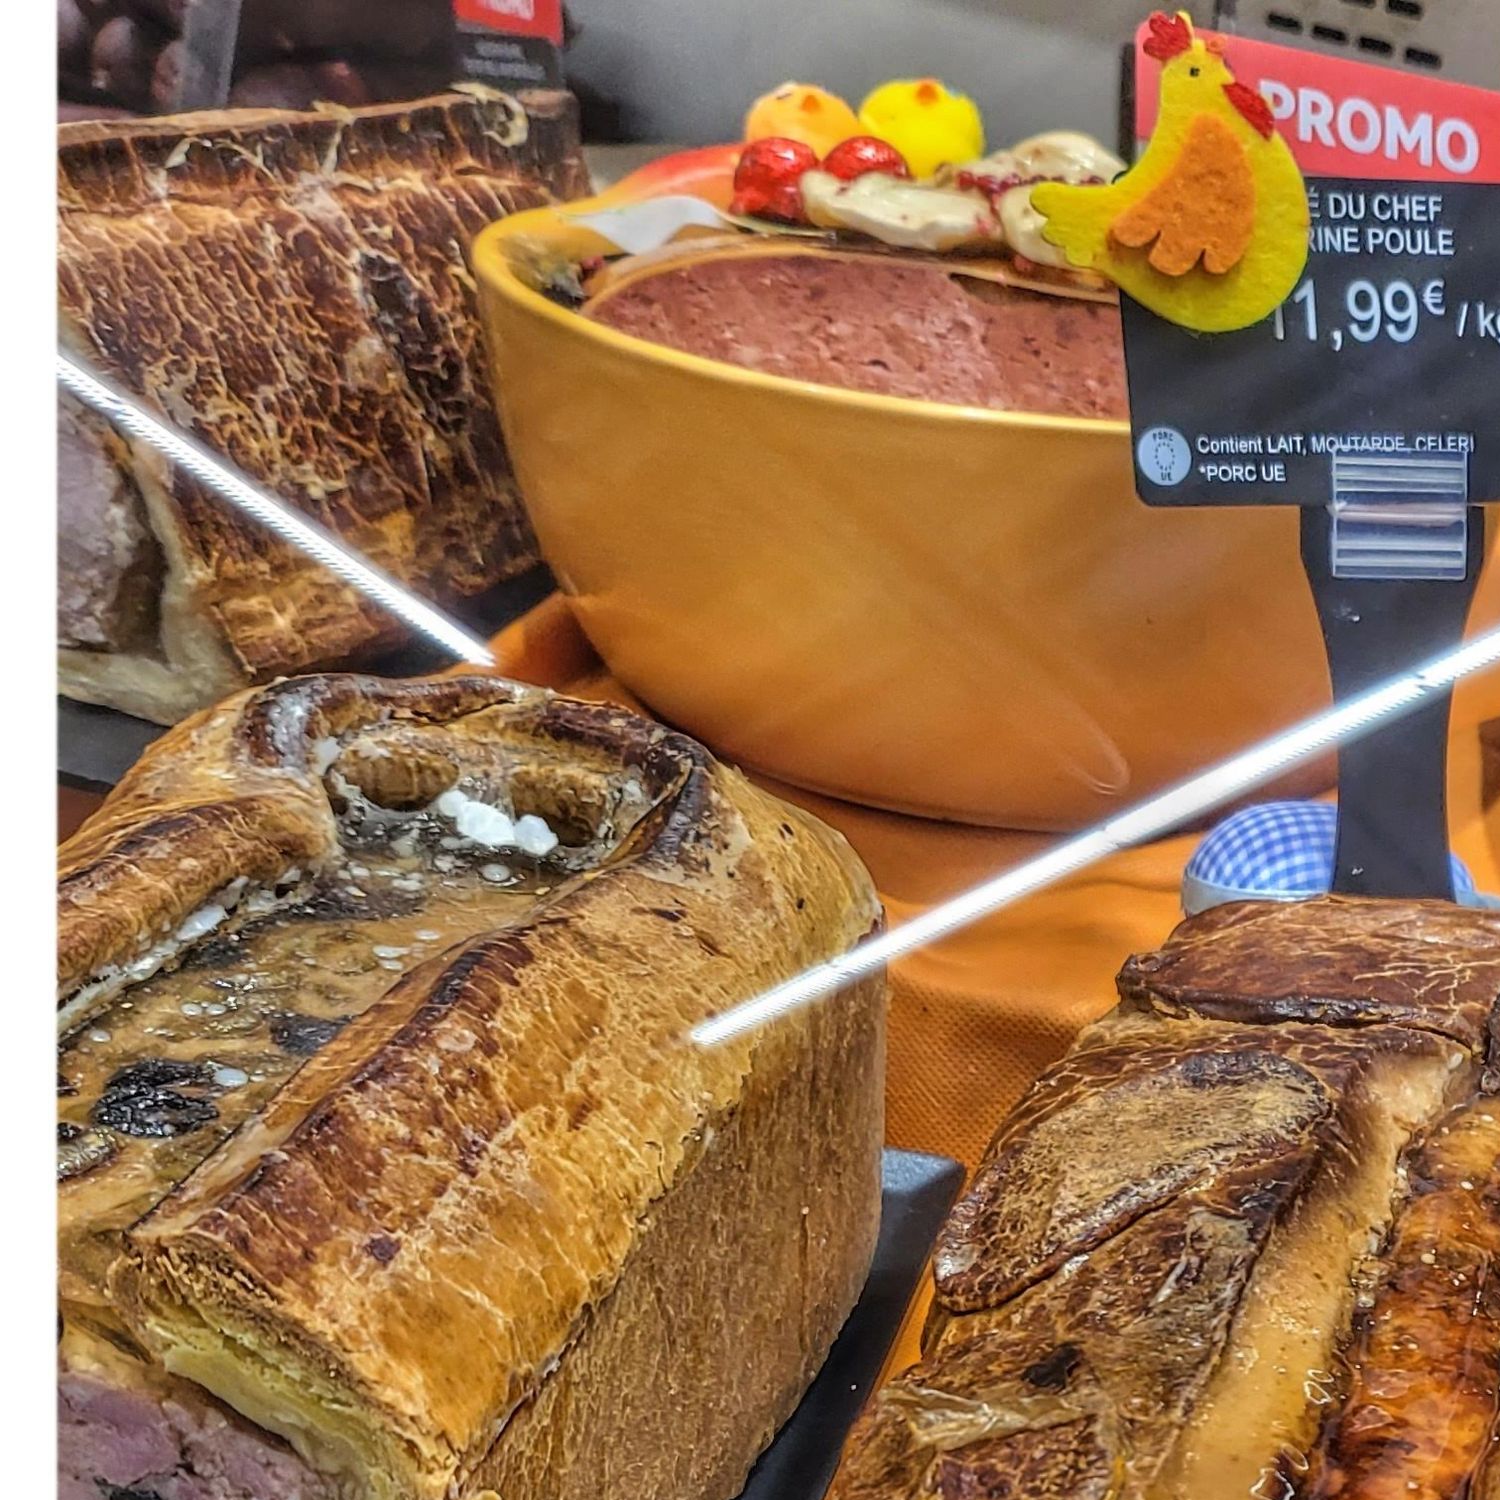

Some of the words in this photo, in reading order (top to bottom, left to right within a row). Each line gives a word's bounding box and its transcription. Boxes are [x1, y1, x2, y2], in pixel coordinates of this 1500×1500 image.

[1259, 79, 1480, 174] PROMO
[1328, 192, 1366, 220] DU
[1373, 194, 1442, 222] CHEF
[1368, 228, 1454, 256] POULE
[1197, 436, 1263, 454] Contient
[1267, 437, 1307, 457] LAIT,
[1261, 464, 1287, 482] UE
